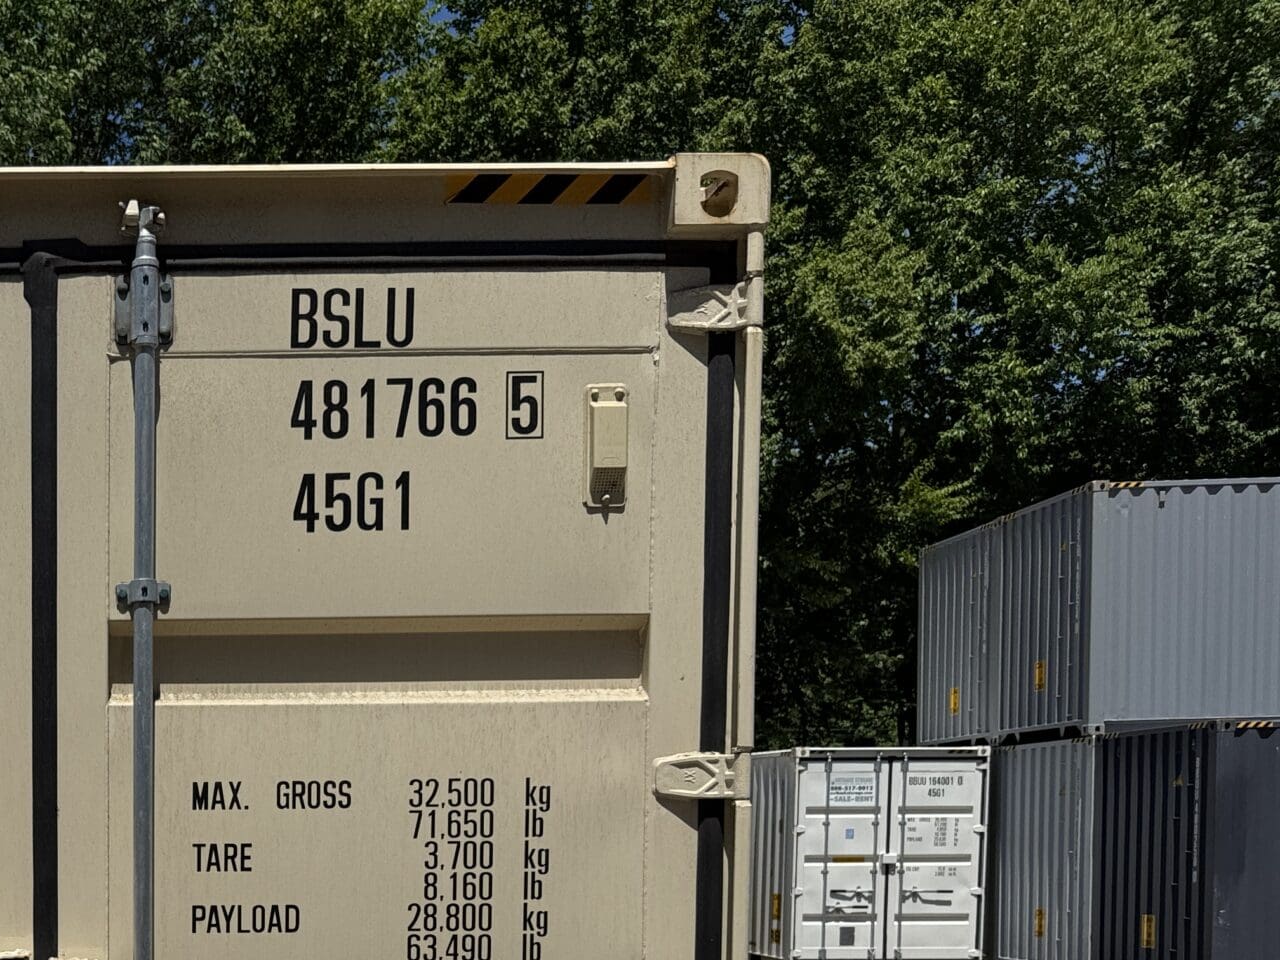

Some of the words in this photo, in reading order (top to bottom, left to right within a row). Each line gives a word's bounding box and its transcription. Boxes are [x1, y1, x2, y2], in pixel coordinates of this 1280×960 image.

[290, 287, 415, 348] BSLU
[290, 376, 477, 440] 481766
[511, 375, 538, 435] 5
[293, 471, 410, 533] 45G1
[192, 781, 250, 811] MAX.
[276, 780, 352, 810] GROSS
[408, 778, 495, 810] 32,500
[525, 777, 551, 812] kg
[408, 810, 495, 840] 71,650
[524, 809, 544, 838] lb
[192, 843, 253, 872] TARE
[424, 841, 494, 871] 3,700
[524, 840, 550, 875] kg
[423, 872, 494, 902] 8,160
[523, 871, 543, 900] lb
[191, 904, 301, 934] PAYLOAD
[407, 903, 493, 934] 28,800
[522, 902, 549, 937] kg
